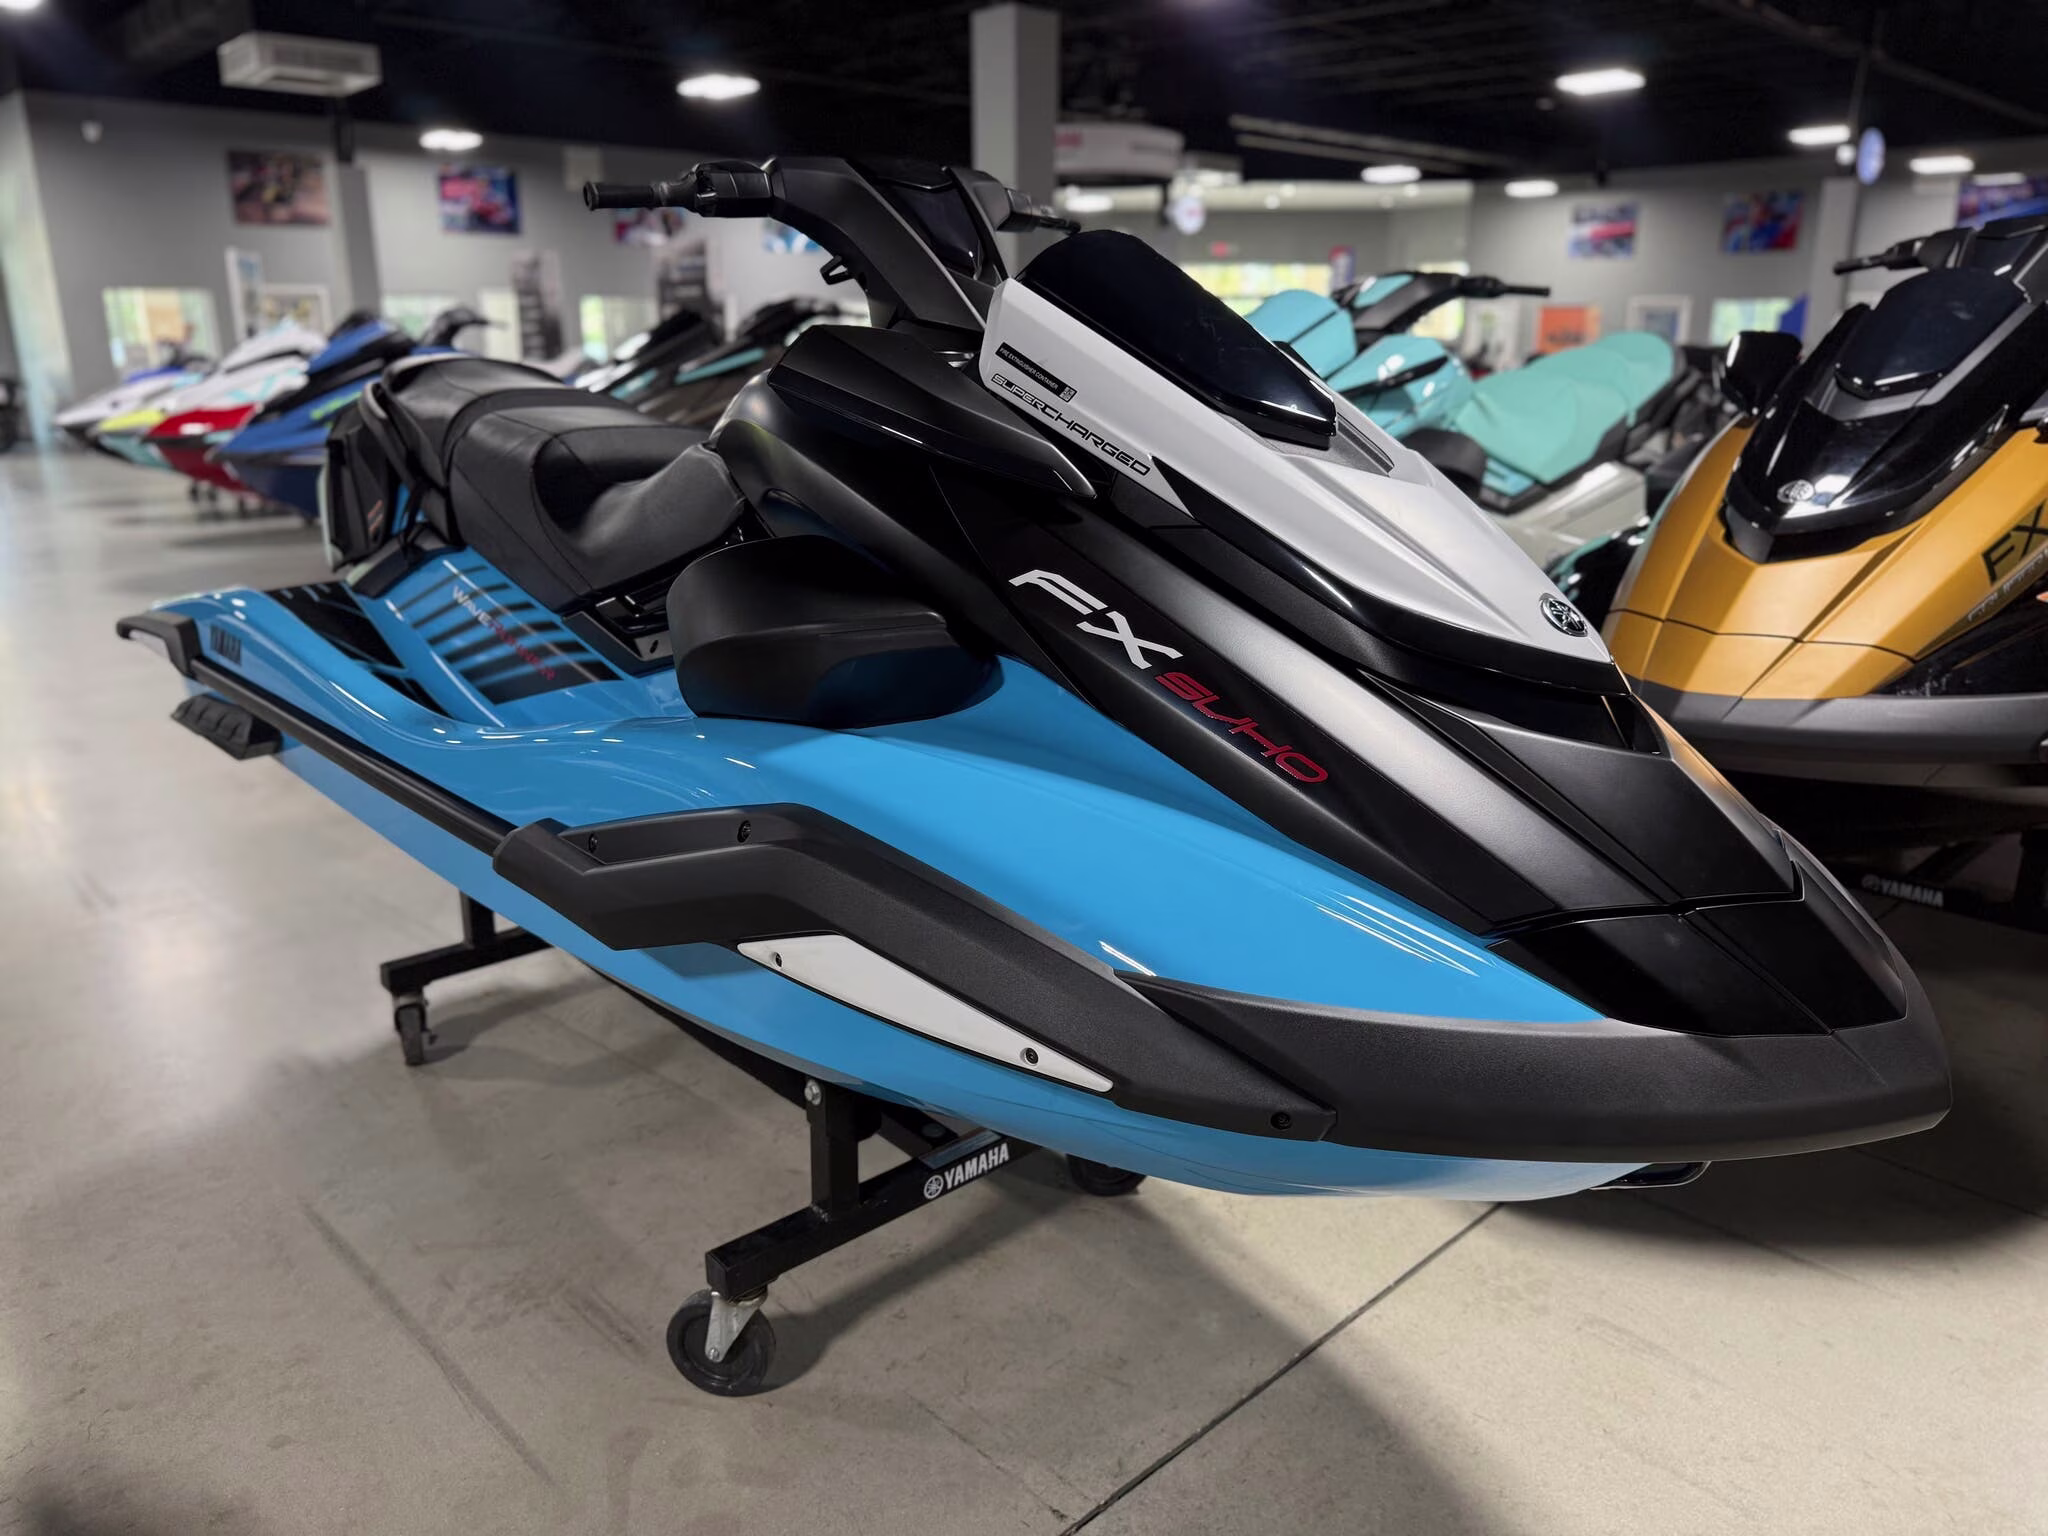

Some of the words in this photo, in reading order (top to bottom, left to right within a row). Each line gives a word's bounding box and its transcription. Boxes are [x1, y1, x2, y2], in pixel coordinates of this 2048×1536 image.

[1008, 353, 1037, 375] EXTINGUISHER
[1035, 371, 1059, 390] CONTAINER
[991, 373, 1151, 476] SUPERCHARGED
[1981, 499, 2048, 586] FX
[1008, 569, 1184, 670] FX
[1880, 879, 1944, 907] YAMAHA
[944, 1142, 1010, 1190] YAMAHA
